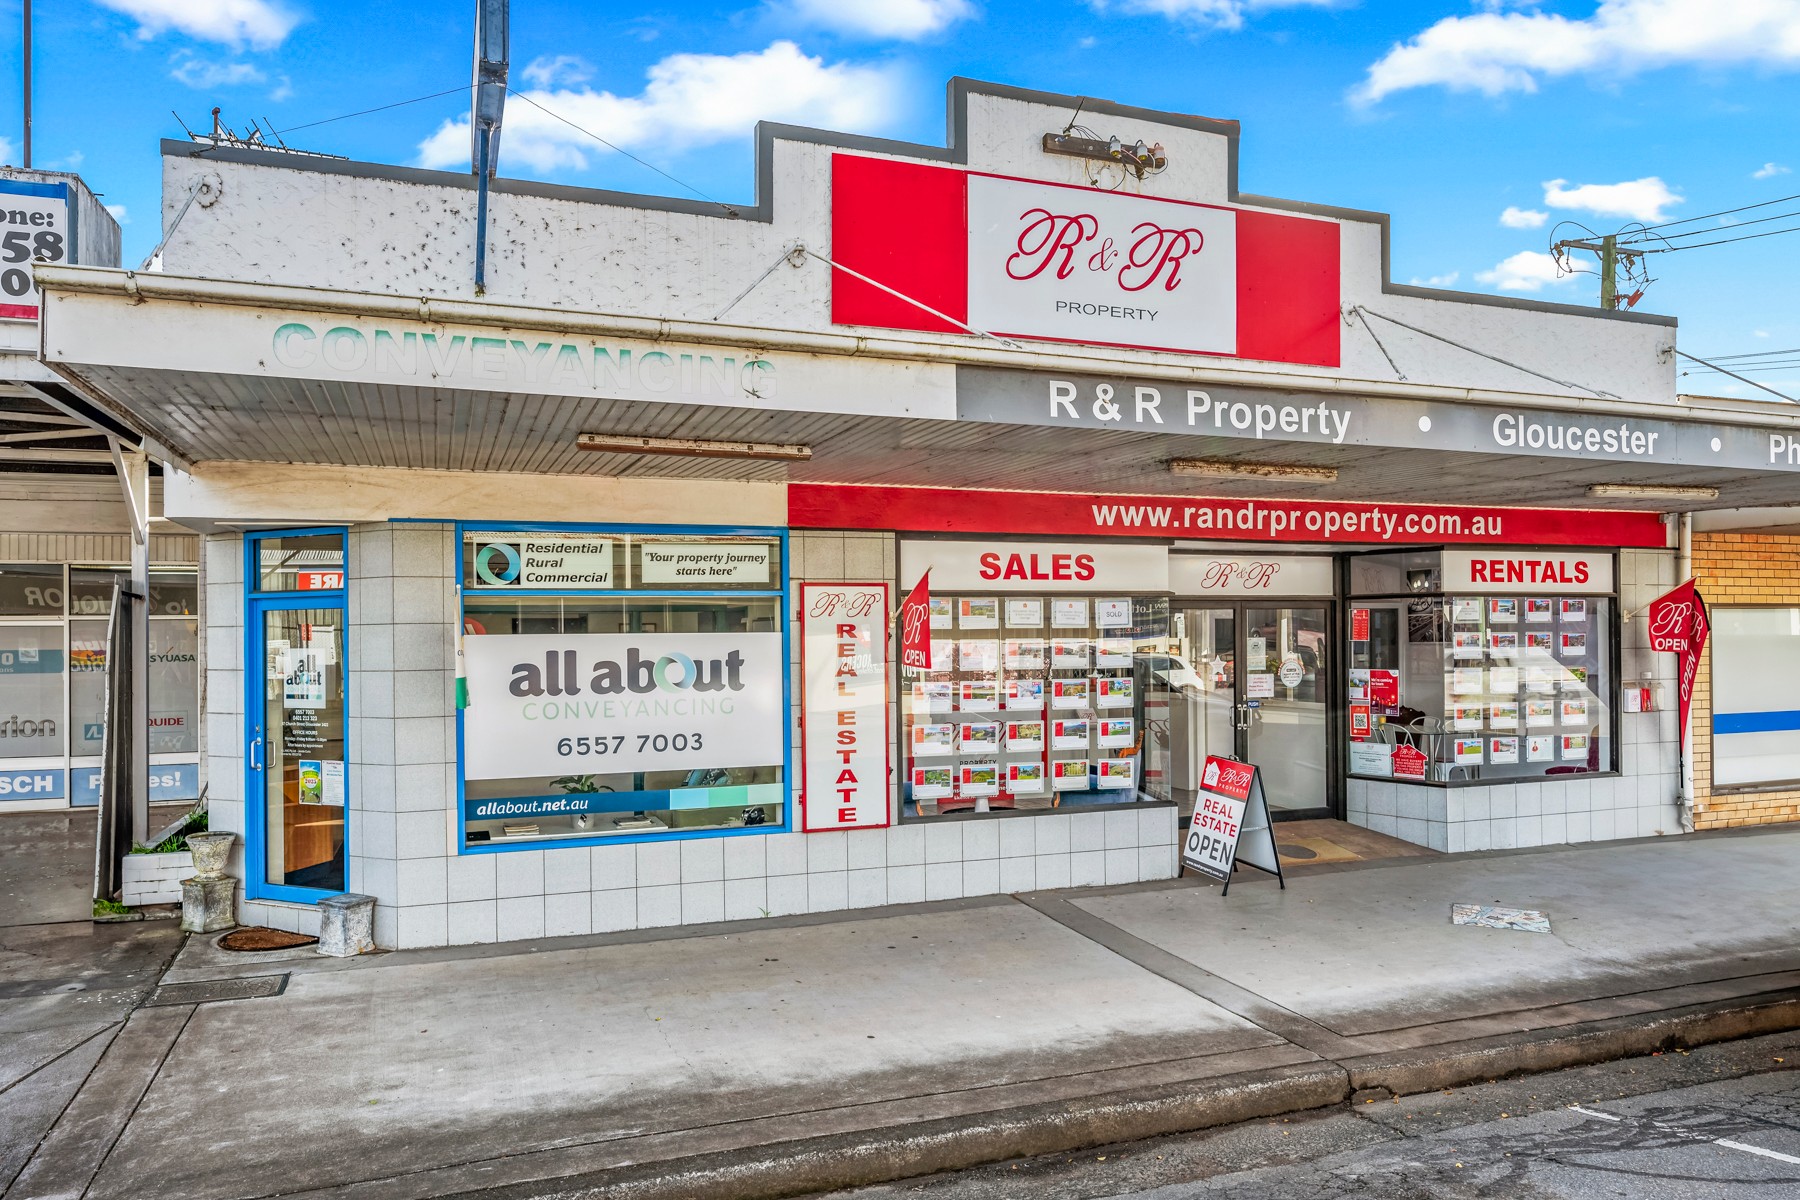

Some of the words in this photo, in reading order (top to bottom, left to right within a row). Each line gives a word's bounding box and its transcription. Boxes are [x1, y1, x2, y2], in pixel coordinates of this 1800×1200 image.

[2, 230, 64, 263] 58
[1006, 208, 1098, 280] R
[1088, 237, 1118, 271] &
[1118, 222, 1204, 292] R
[1, 268, 40, 297] 0
[1056, 301, 1158, 321] PROPERTY
[272, 322, 778, 399] CONVEYANCING
[1050, 380, 1080, 419] R
[1092, 383, 1122, 422] &
[1134, 386, 1164, 424] R
[1187, 390, 1352, 444] Property
[1492, 413, 1658, 455] Gloucester
[1769, 434, 1800, 464] Ph
[1092, 503, 1503, 541] www.randrproperty.com.au
[525, 543, 603, 554] Residential
[644, 550, 674, 563] "Your
[677, 552, 723, 565] property
[725, 554, 766, 565] journey
[525, 556, 563, 568] Rural
[676, 566, 707, 577] starts
[709, 567, 738, 577] here"
[979, 552, 1096, 581] SALES
[1470, 559, 1589, 584] RENTALS
[525, 571, 608, 583] Commercial
[1201, 561, 1239, 589] R
[1236, 568, 1247, 579] &
[1243, 562, 1281, 589] R
[810, 591, 846, 618] R
[841, 600, 850, 609] &
[846, 591, 882, 617] R
[904, 602, 928, 645] R
[1651, 602, 1692, 635] R
[1655, 638, 1688, 650] OPEN
[158, 654, 195, 662] YUASA
[297, 655, 316, 673] all
[836, 624, 859, 697] REAL
[904, 649, 926, 667] OPEN
[286, 670, 321, 685] about
[509, 650, 581, 697] all
[590, 648, 745, 693] about
[1681, 650, 1697, 702] OPEN
[522, 697, 735, 720] CONVEYANCING
[557, 736, 626, 756] 6557
[636, 732, 703, 753] 7003
[836, 710, 858, 822] ESTATE
[1221, 768, 1237, 783] R
[1234, 772, 1251, 787] R
[0, 775, 53, 793] SCH
[1219, 783, 1246, 795] PROPERTY
[476, 798, 589, 816] allabout.net.au
[1203, 799, 1233, 819] REAL
[1193, 813, 1237, 837] ESTATE
[1189, 832, 1233, 866] OPEN
